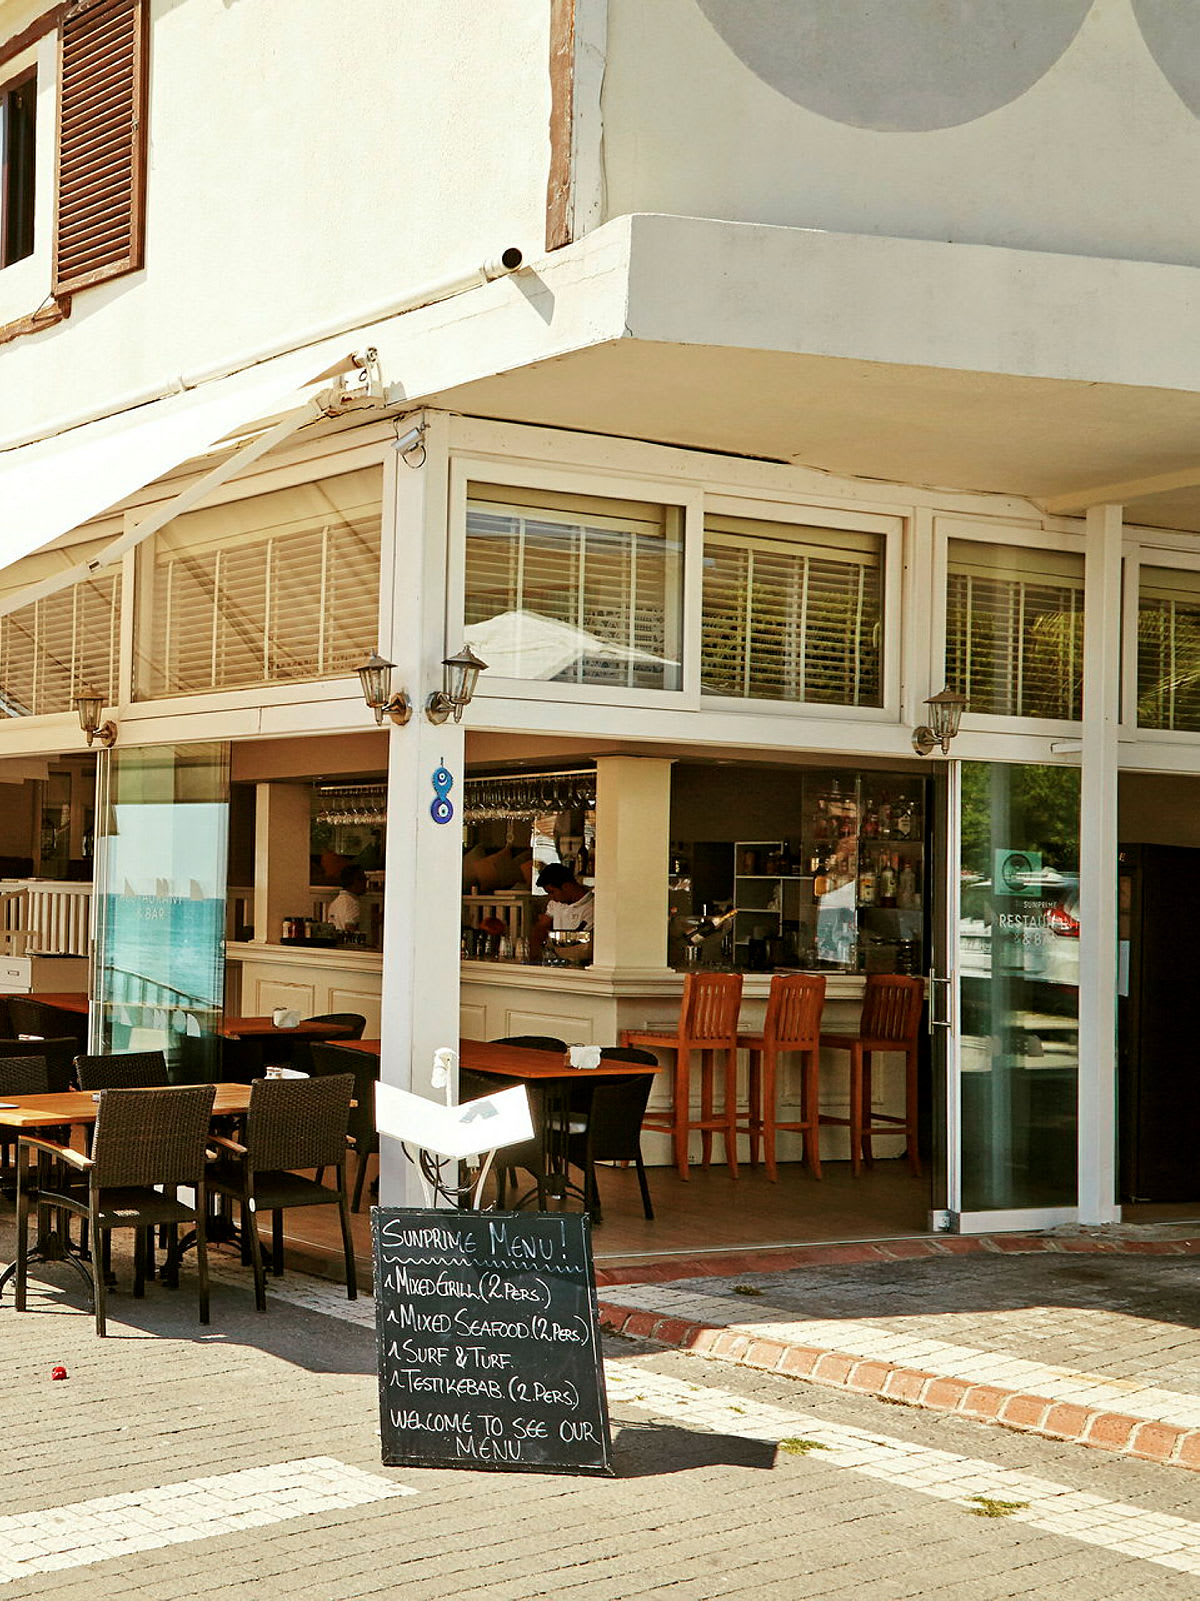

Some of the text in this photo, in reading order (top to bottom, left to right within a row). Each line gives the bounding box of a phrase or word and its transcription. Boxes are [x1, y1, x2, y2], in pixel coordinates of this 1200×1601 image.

[999, 913, 1080, 929] RESTAU
[381, 1218, 477, 1253] SUNPRIME
[395, 1265, 435, 1297] MIXED
[400, 1303, 452, 1333] MIXED
[402, 1338, 450, 1367] SURF
[455, 1345, 469, 1369] &
[389, 1408, 601, 1445] WELCOME TO SEE OUR
